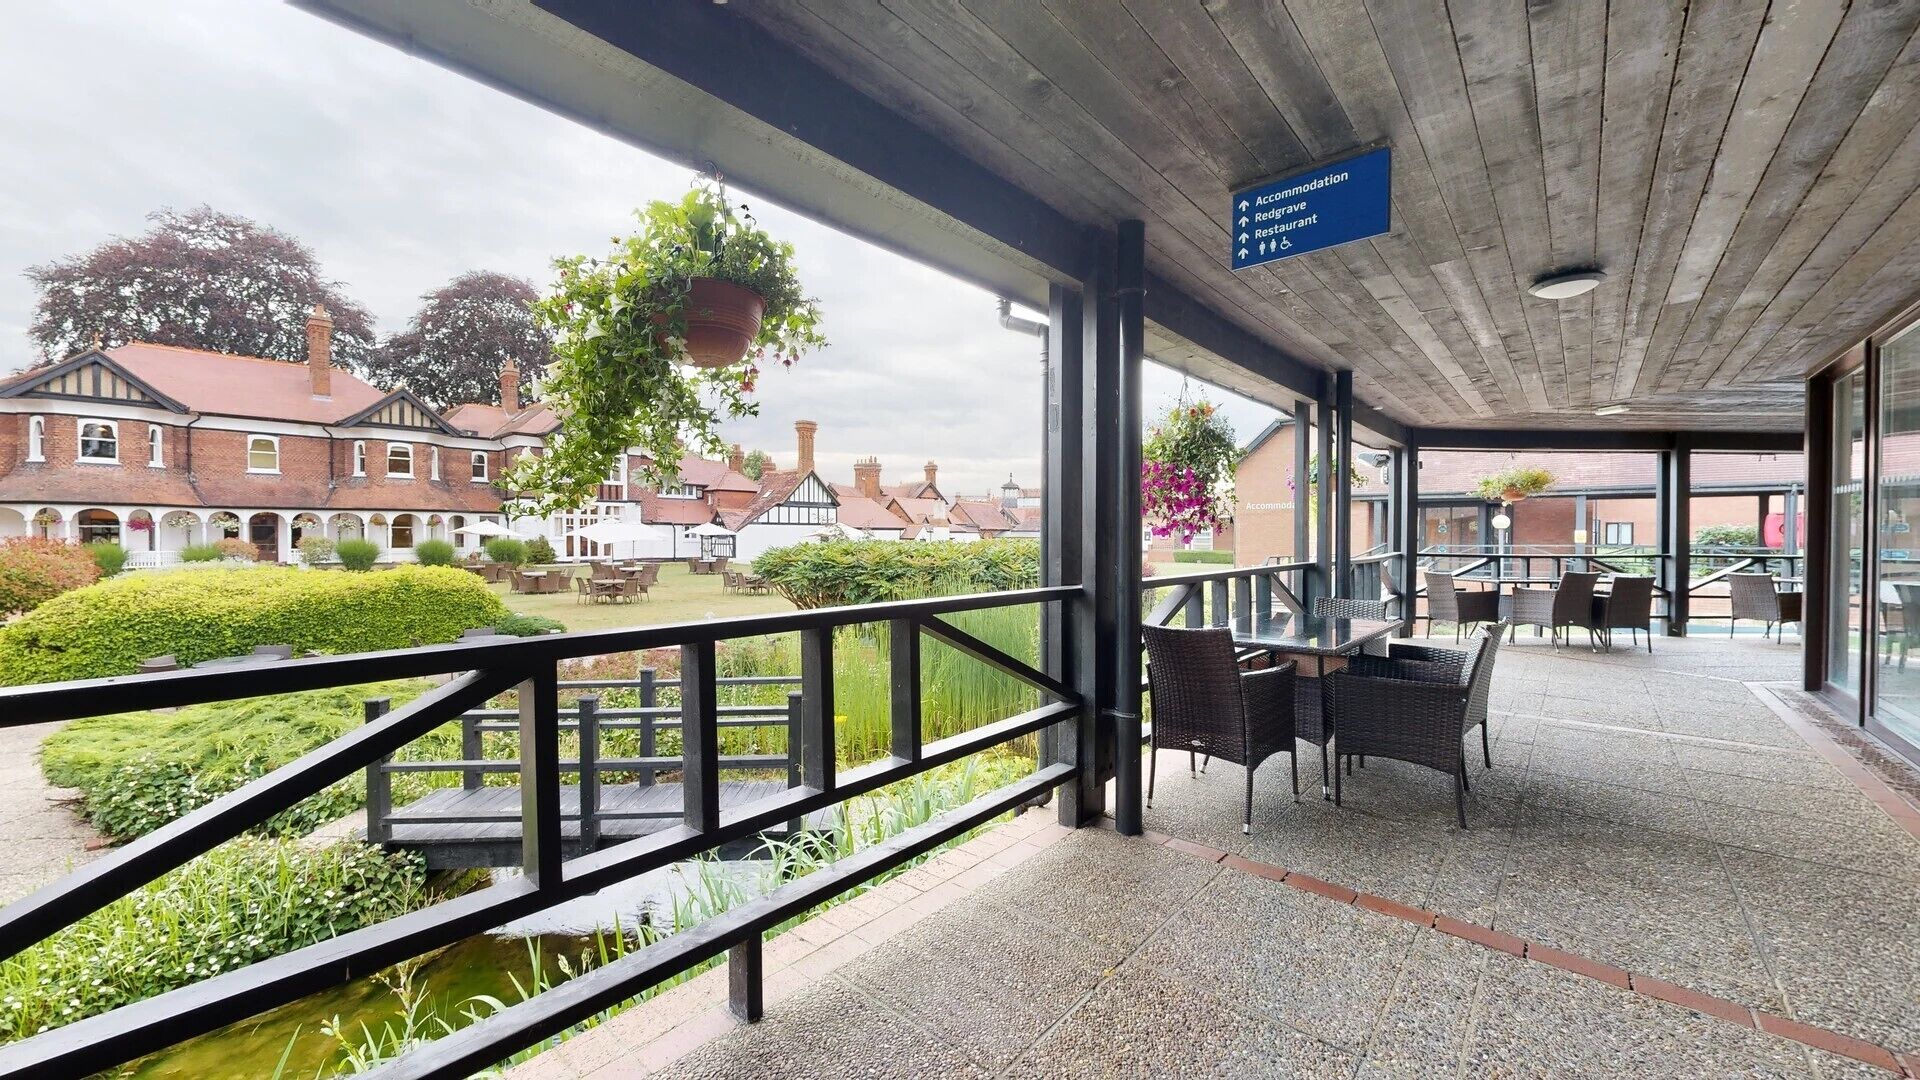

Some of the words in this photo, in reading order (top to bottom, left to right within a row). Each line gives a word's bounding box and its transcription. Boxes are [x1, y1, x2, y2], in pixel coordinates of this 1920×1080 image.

[1255, 172, 1348, 207] Accommodation
[1254, 201, 1307, 223] Redgrave
[1254, 213, 1318, 240] Restaurant
